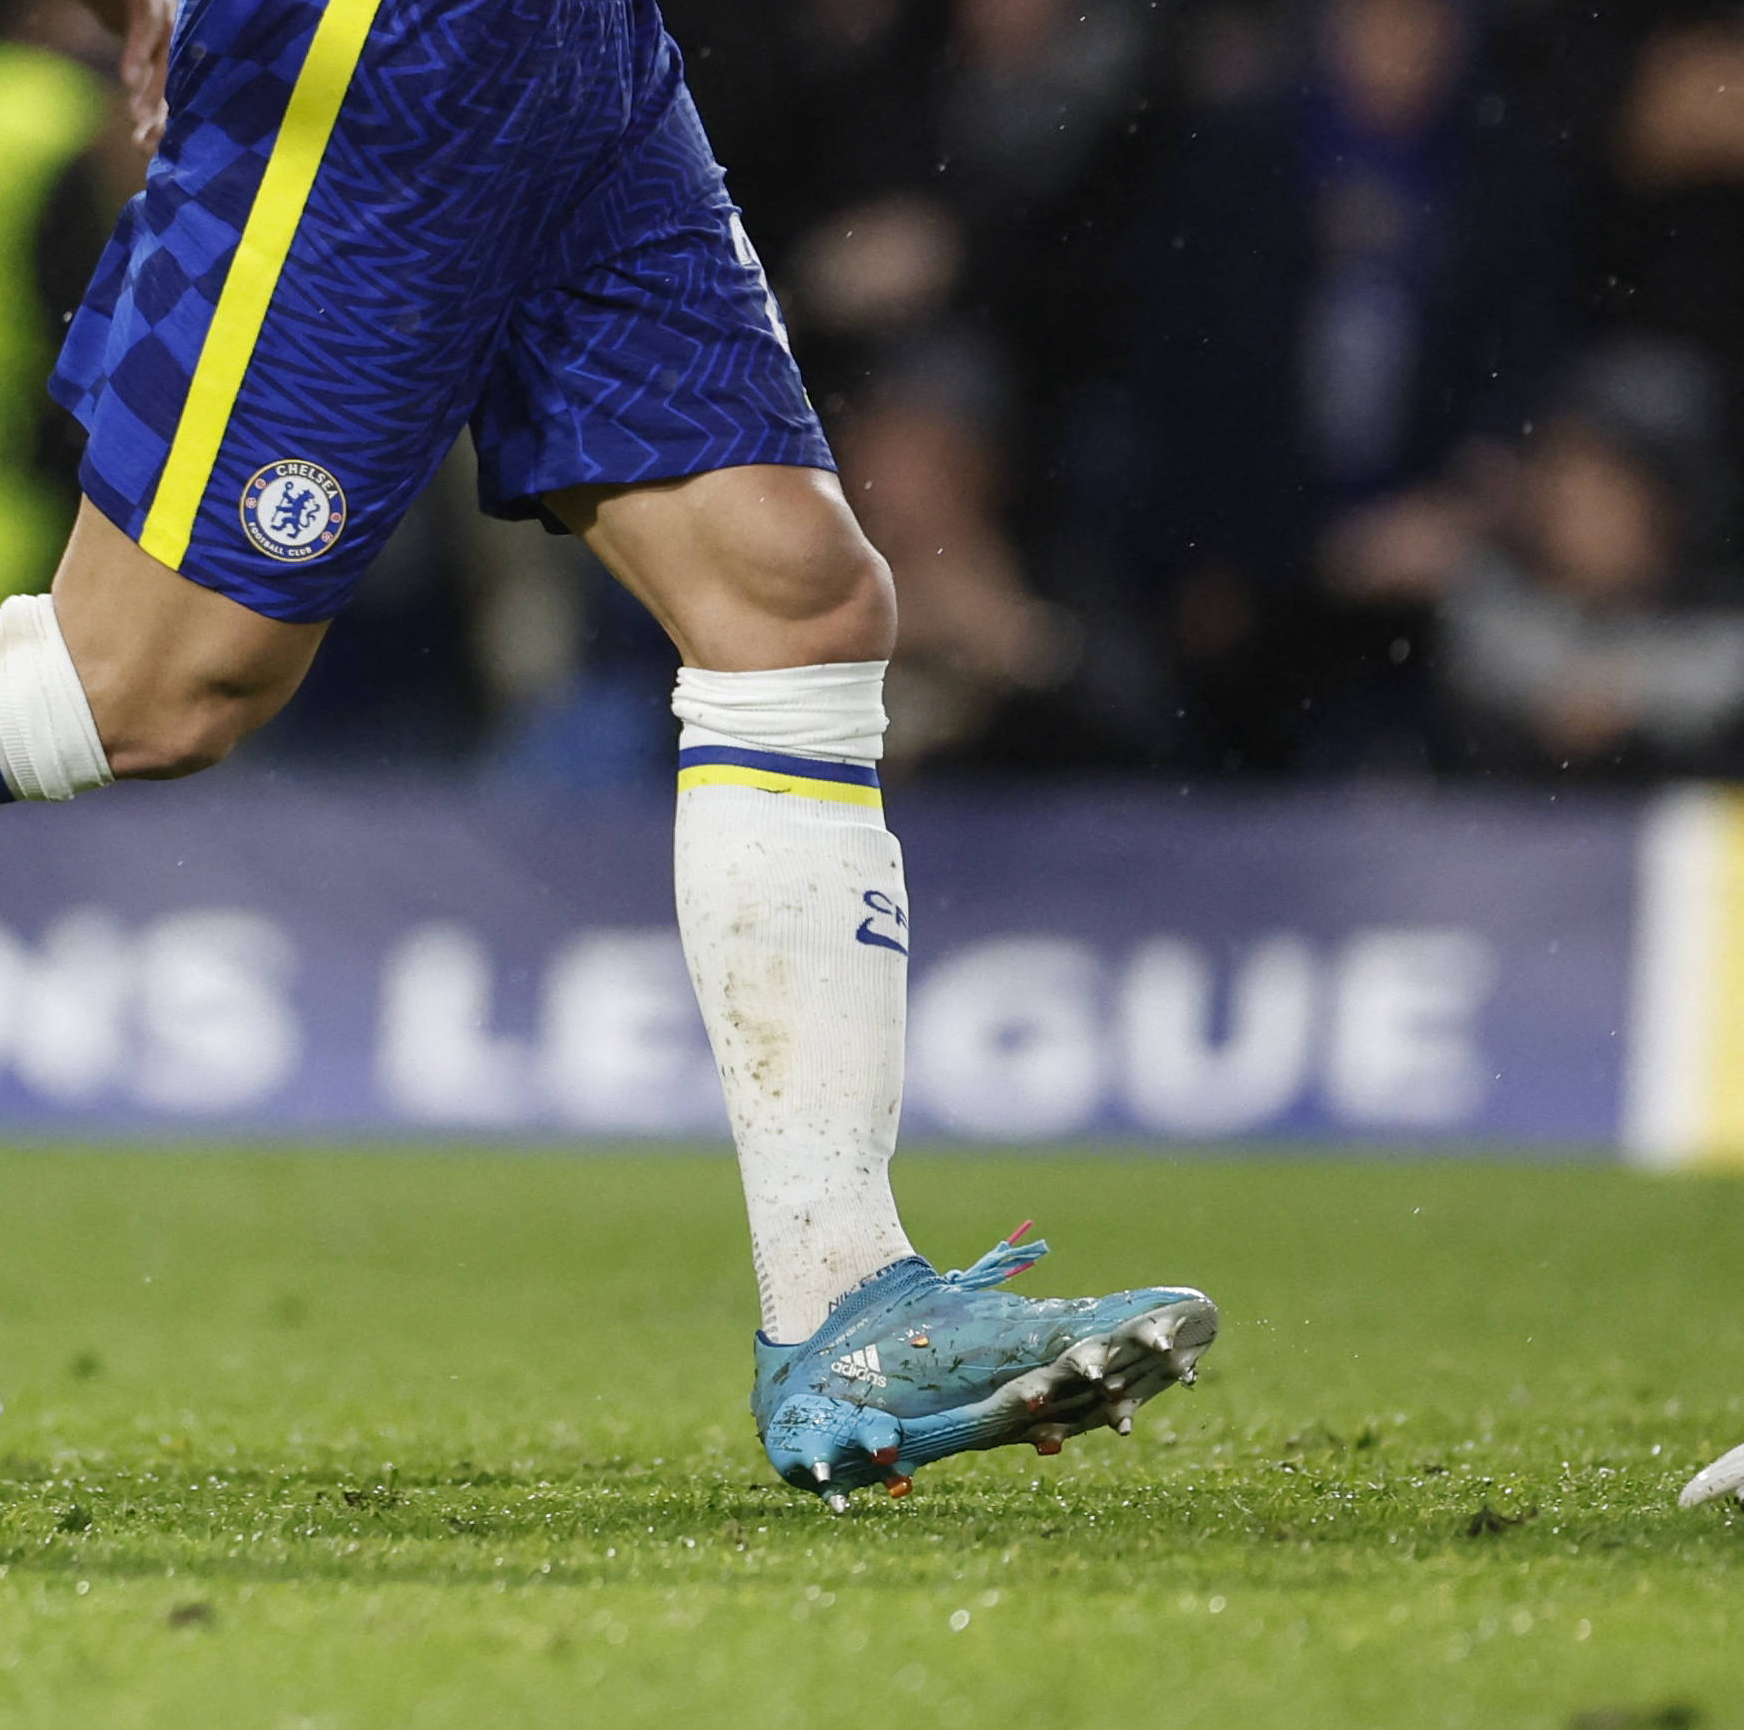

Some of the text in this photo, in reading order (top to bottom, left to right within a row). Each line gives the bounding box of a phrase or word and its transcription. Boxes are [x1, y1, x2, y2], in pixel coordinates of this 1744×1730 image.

[275, 463, 339, 500] CHELSEA
[248, 521, 313, 557] FOOTBALL CLUB
[862, 889, 908, 930] CF
[377, 922, 1499, 1136] LEGUE
[831, 1361, 887, 1388] adidas
